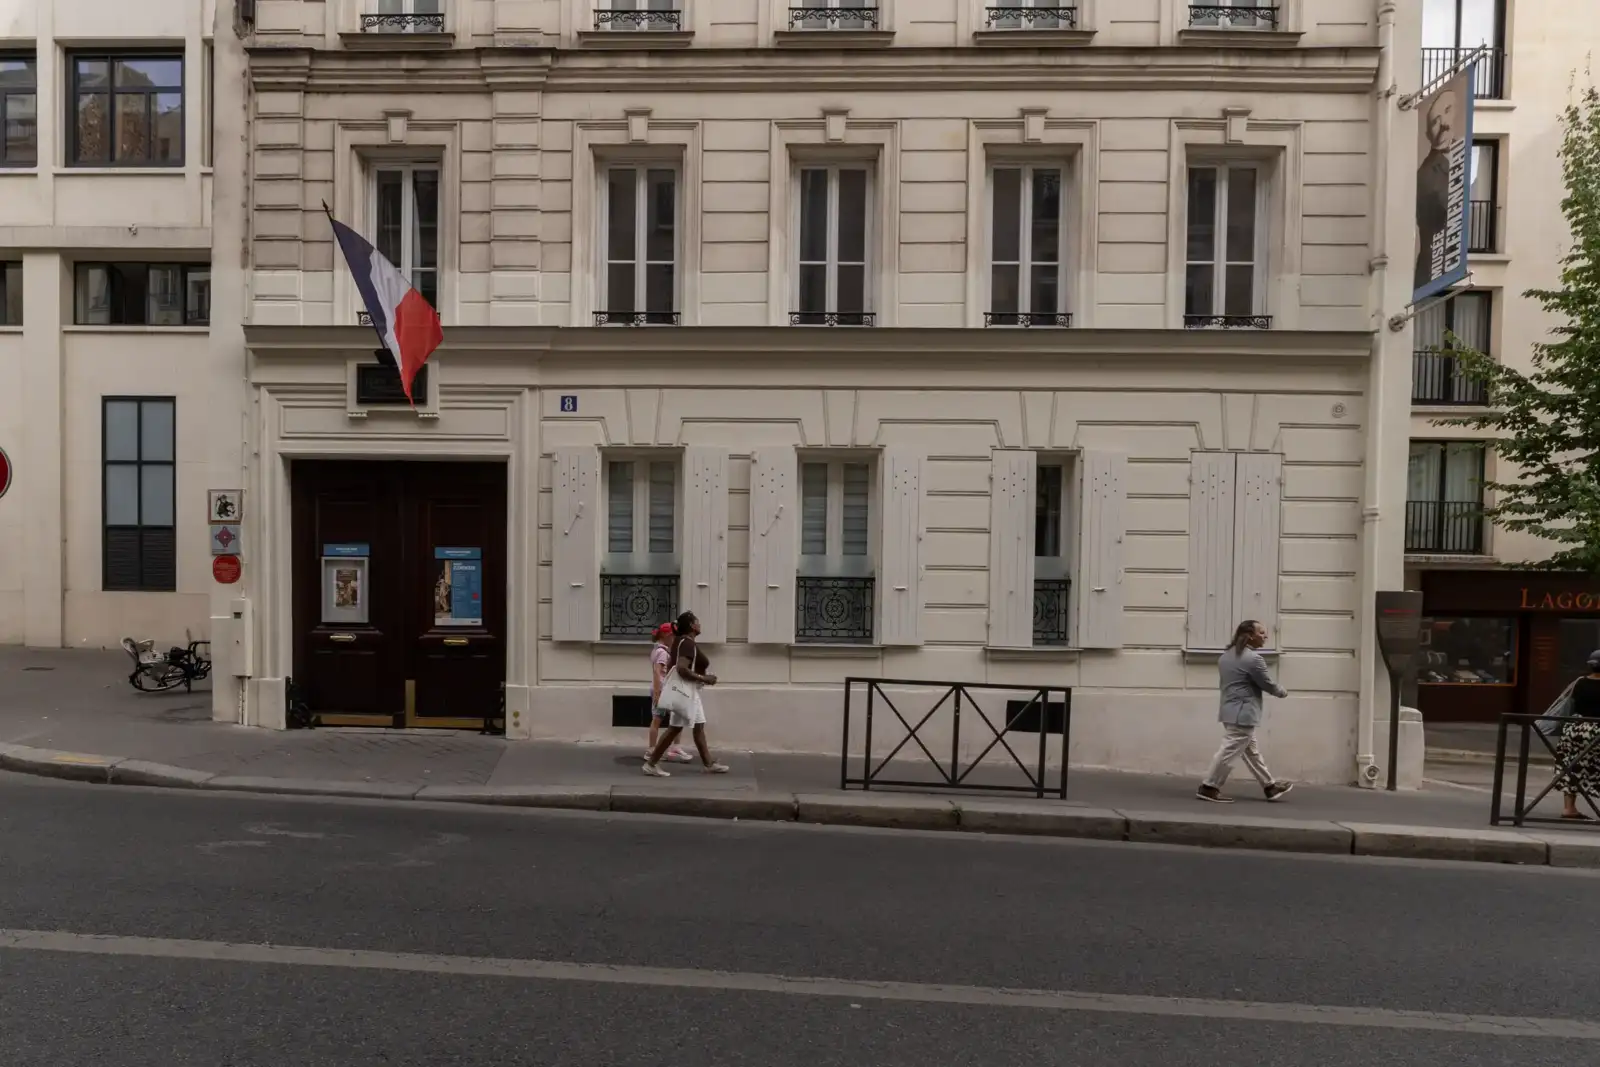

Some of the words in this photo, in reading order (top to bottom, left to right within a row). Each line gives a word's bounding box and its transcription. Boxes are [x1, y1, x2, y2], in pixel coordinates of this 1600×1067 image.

[1444, 138, 1466, 274] CLEMENCEAU
[1431, 228, 1445, 281] MUSÉE
[564, 396, 574, 411] 8
